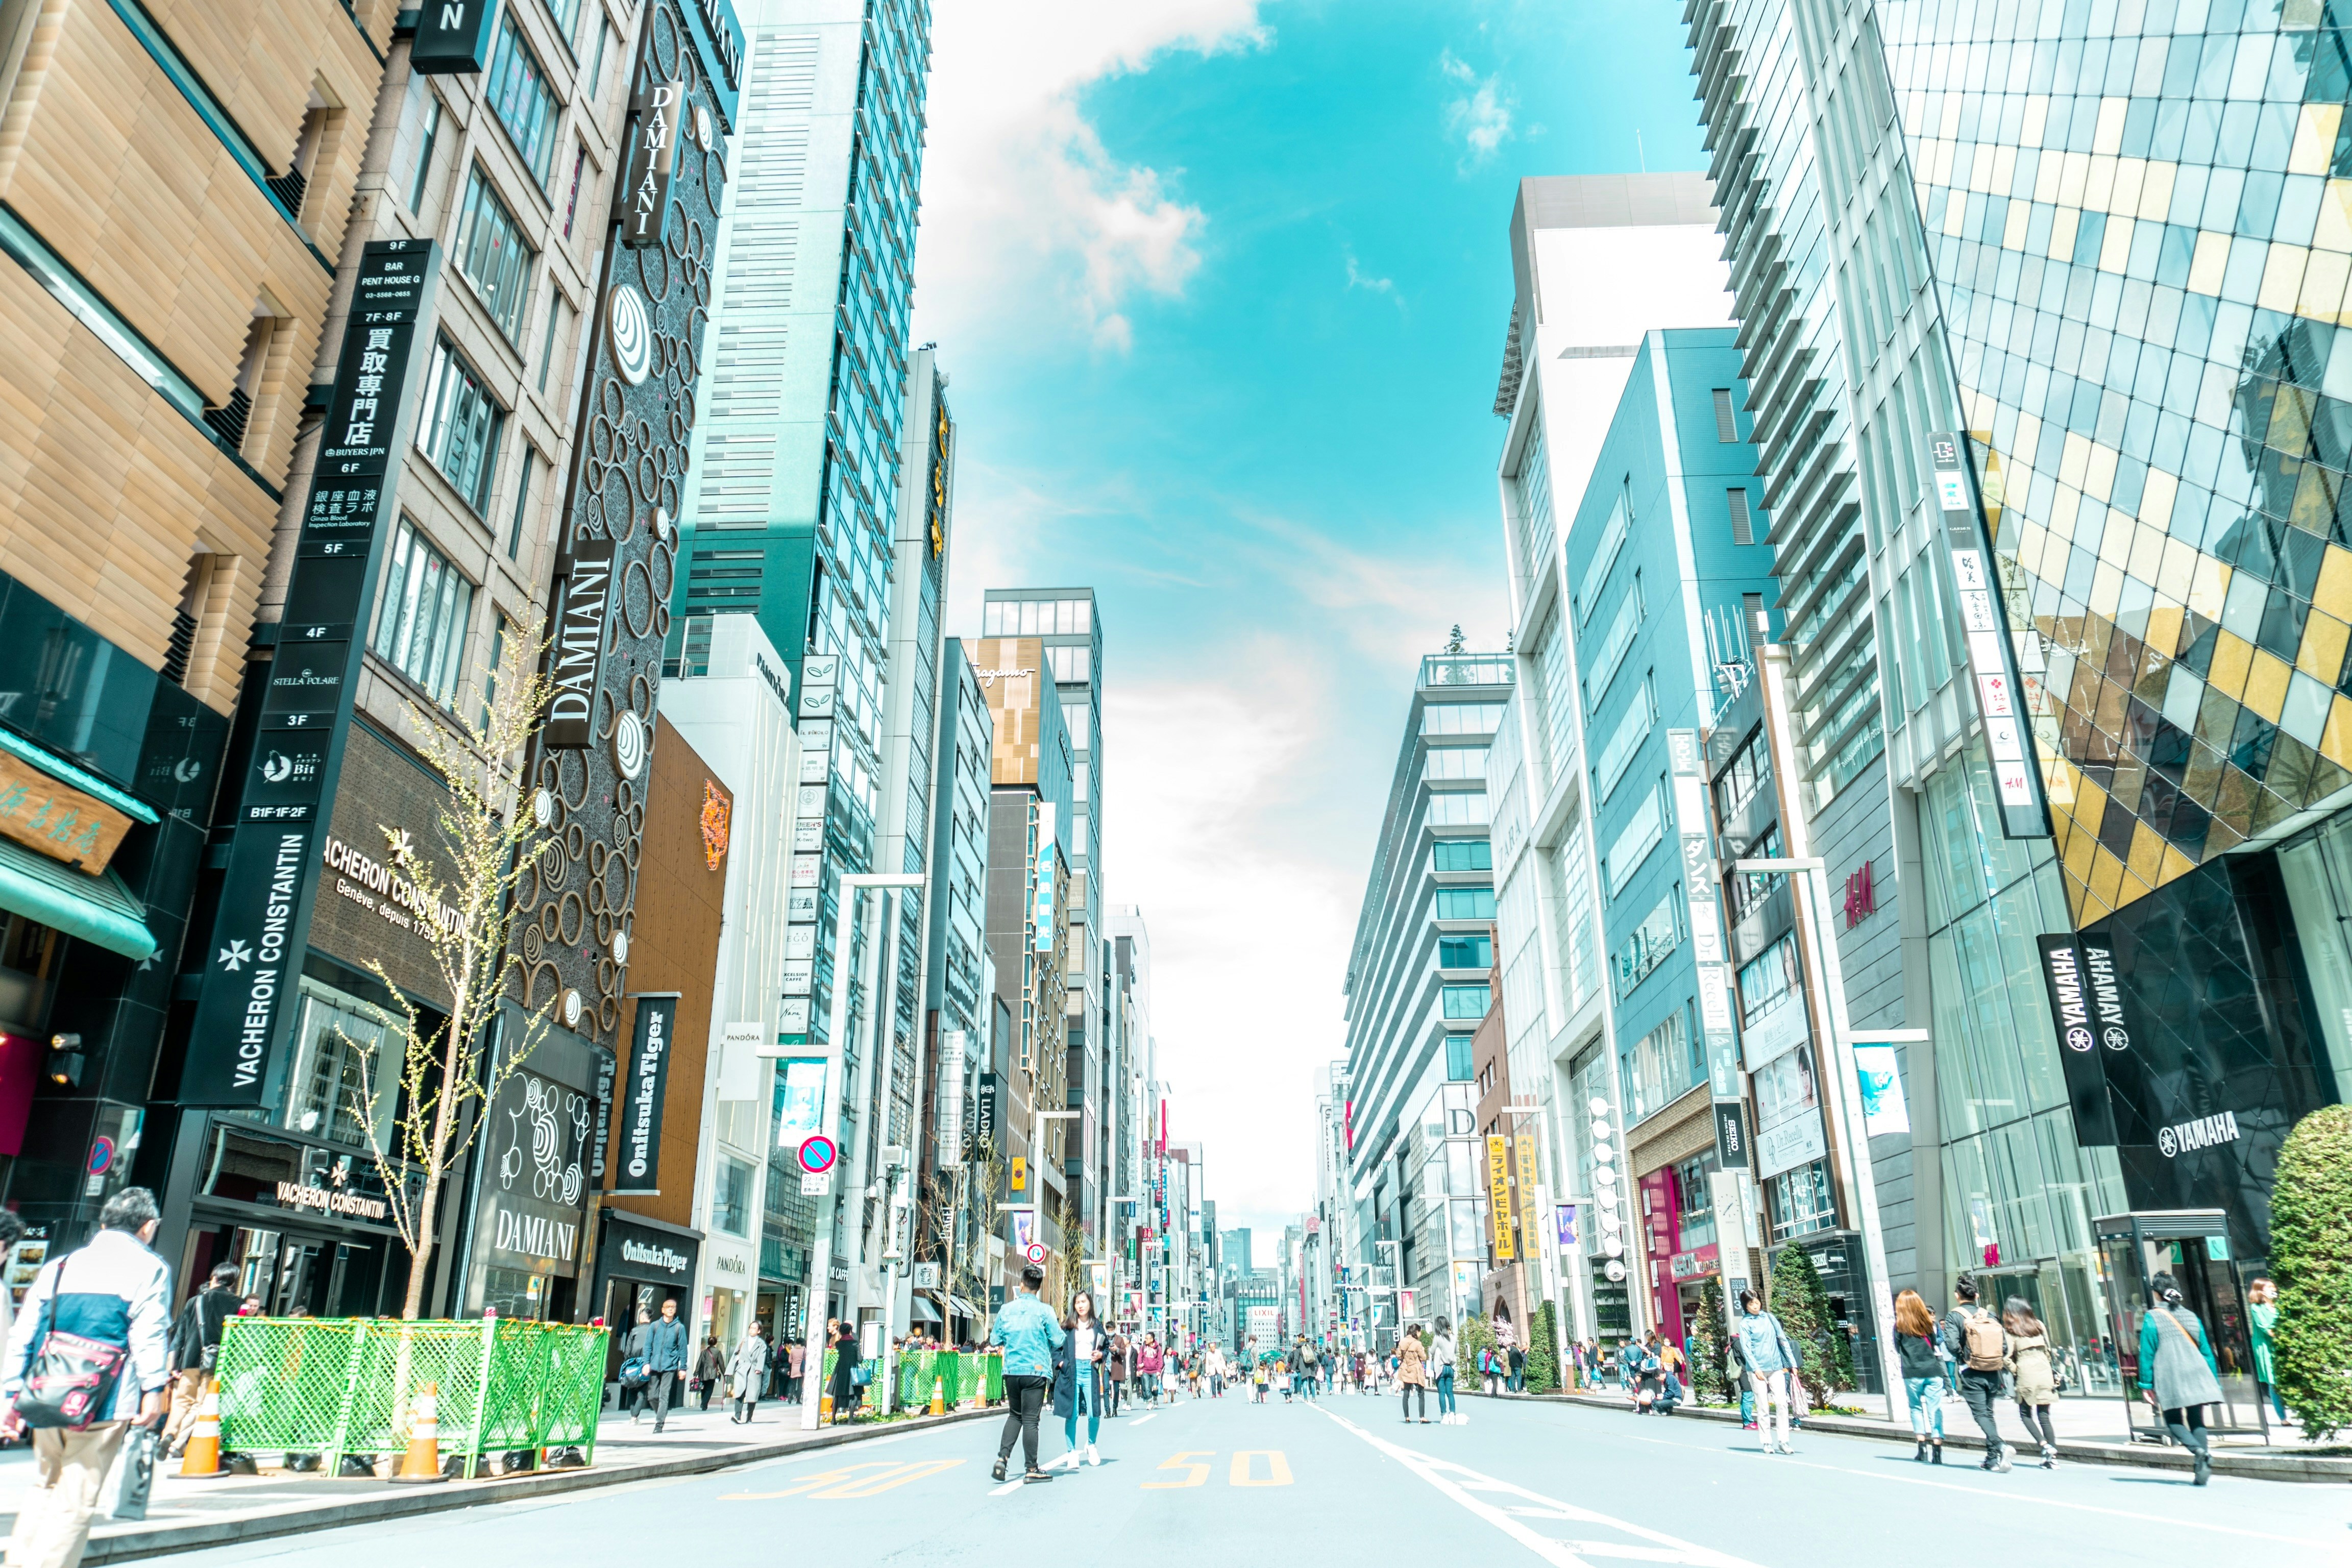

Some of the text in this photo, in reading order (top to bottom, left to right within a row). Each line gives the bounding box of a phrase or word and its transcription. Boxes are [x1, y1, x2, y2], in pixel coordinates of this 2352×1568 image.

[636, 86, 674, 235] DAMIANI
[389, 241, 407, 250] 9F
[361, 275, 421, 286] PENT HOUSE G
[384, 262, 404, 271] BAR
[344, 328, 393, 447] 買取専門店
[335, 447, 385, 456] BUYERS JPN
[341, 463, 360, 473] 6F
[311, 501, 375, 515] 検査ラボ
[314, 489, 378, 503] 銀座血液
[324, 544, 344, 554] 5F
[306, 627, 327, 638] 4F
[550, 557, 610, 723] DAMIANI
[273, 676, 339, 685] STELLA POLARE
[287, 715, 308, 725] 3F
[292, 764, 315, 774] Bit
[2004, 776, 2023, 789] H&M
[1498, 815, 1522, 871] ZARA
[1684, 839, 1711, 895] ダンス
[258, 835, 304, 963] CONSTANTIN
[336, 878, 375, 912] Genève,
[379, 902, 409, 928] depuis
[391, 877, 468, 939] CONSANTIN
[1038, 860, 1052, 939] 名鉄観光
[2050, 947, 2088, 1027] YAMAHA
[233, 969, 278, 1088] VACHERON
[628, 1011, 664, 1178] OnitsukaTiger
[1728, 1119, 1739, 1152] SEIKO
[1812, 1118, 1820, 1134] 3F
[2175, 1111, 2242, 1153] YAMAHA
[277, 1181, 386, 1219] VACHERON CONSTANTIN
[1491, 1154, 1511, 1250] ライオンビヤホール
[494, 1209, 576, 1262] DAMIANI
[622, 1238, 688, 1274] OnitsukaTiger
[716, 1255, 746, 1275] PANDÓRA
[1139, 1450, 1295, 1489] 50
